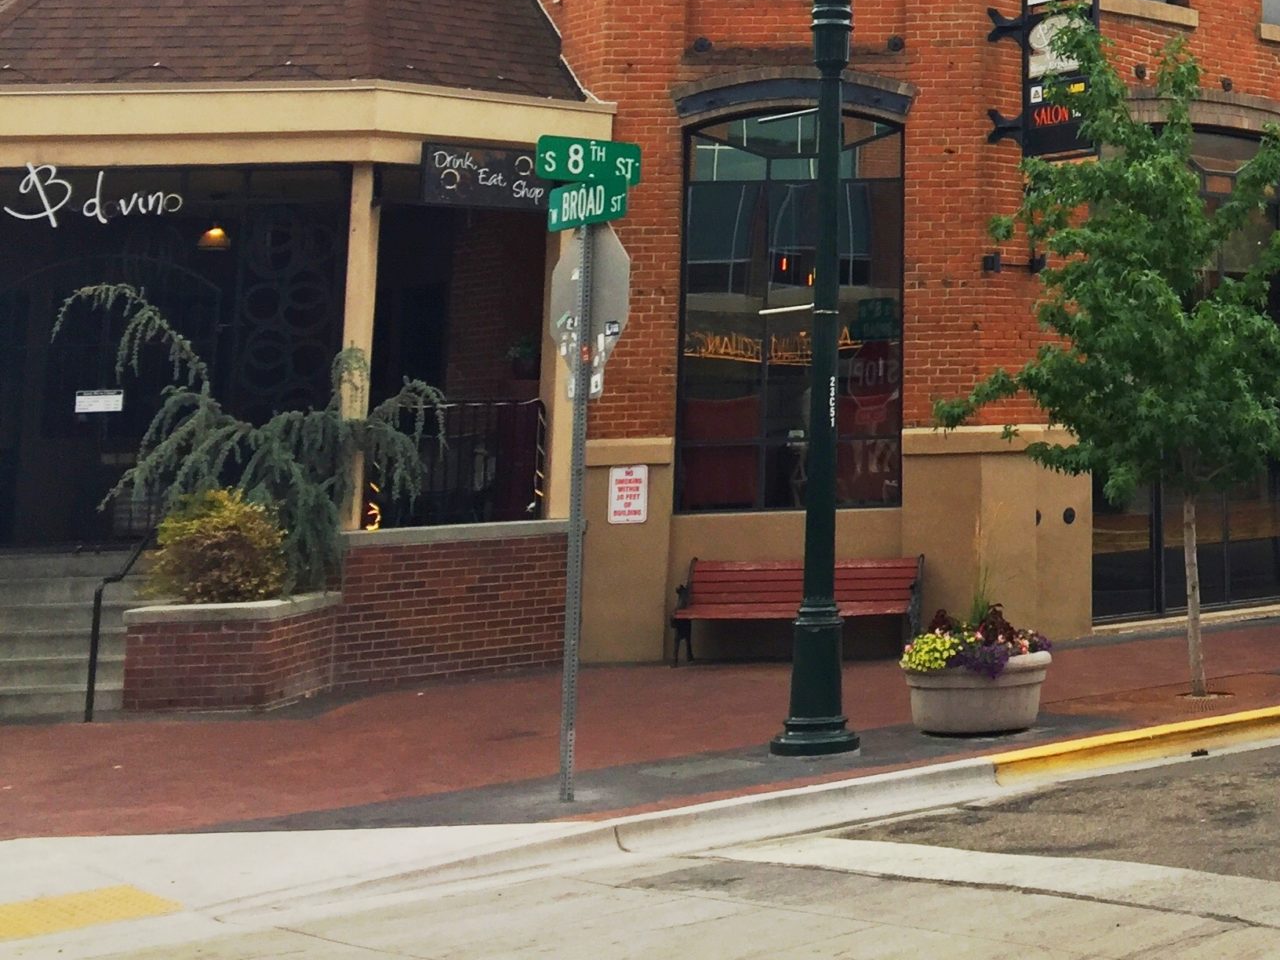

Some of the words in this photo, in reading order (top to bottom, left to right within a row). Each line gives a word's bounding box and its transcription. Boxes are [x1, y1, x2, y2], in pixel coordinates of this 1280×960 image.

[1033, 104, 1069, 128] SALON
[544, 151, 557, 172] S
[567, 144, 606, 174] 8TH
[615, 157, 635, 180] ST
[512, 180, 545, 205] Shop
[561, 184, 605, 222] BROAD
[610, 194, 623, 213] ST
